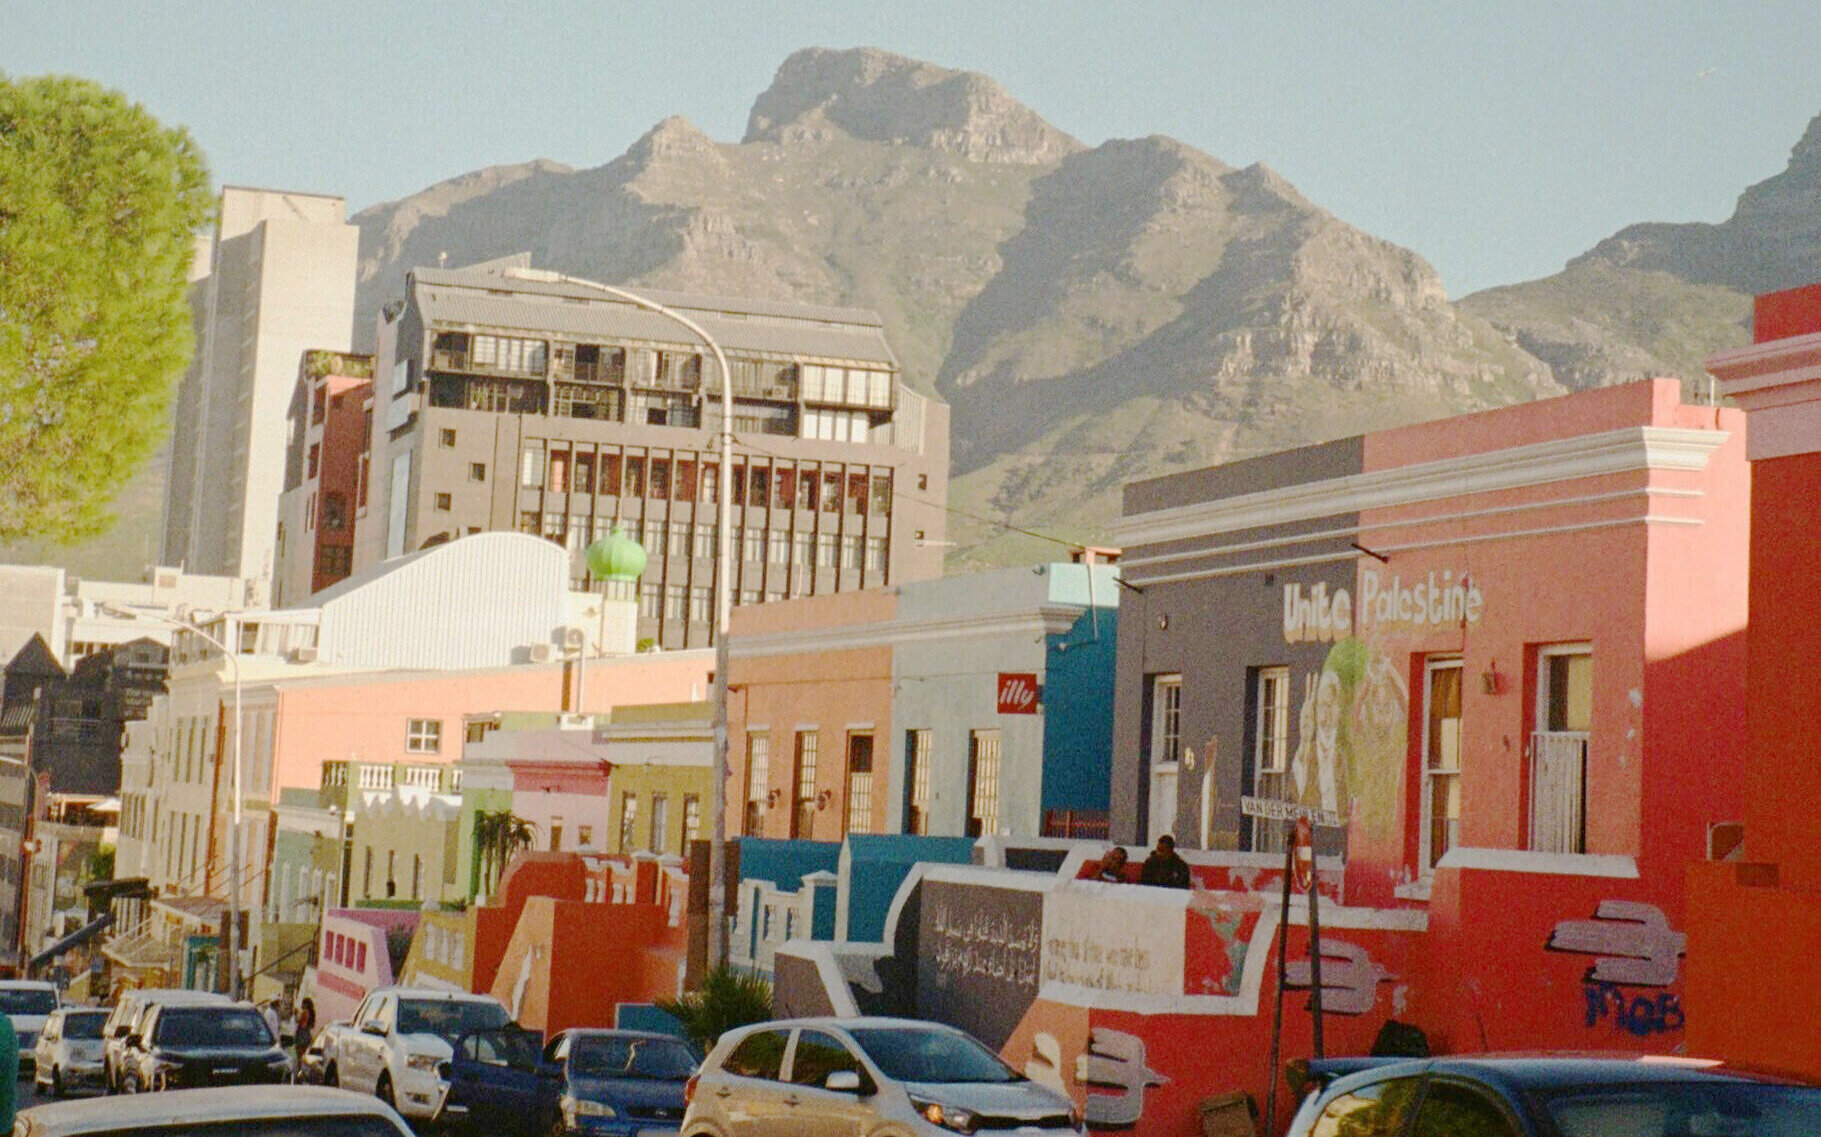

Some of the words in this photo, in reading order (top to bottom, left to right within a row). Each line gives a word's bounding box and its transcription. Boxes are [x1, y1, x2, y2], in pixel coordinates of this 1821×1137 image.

[1284, 580, 1351, 636] Unite
[1360, 569, 1483, 625] Palestine
[1000, 679, 1034, 710] illy
[1245, 799, 1263, 814] VAN
